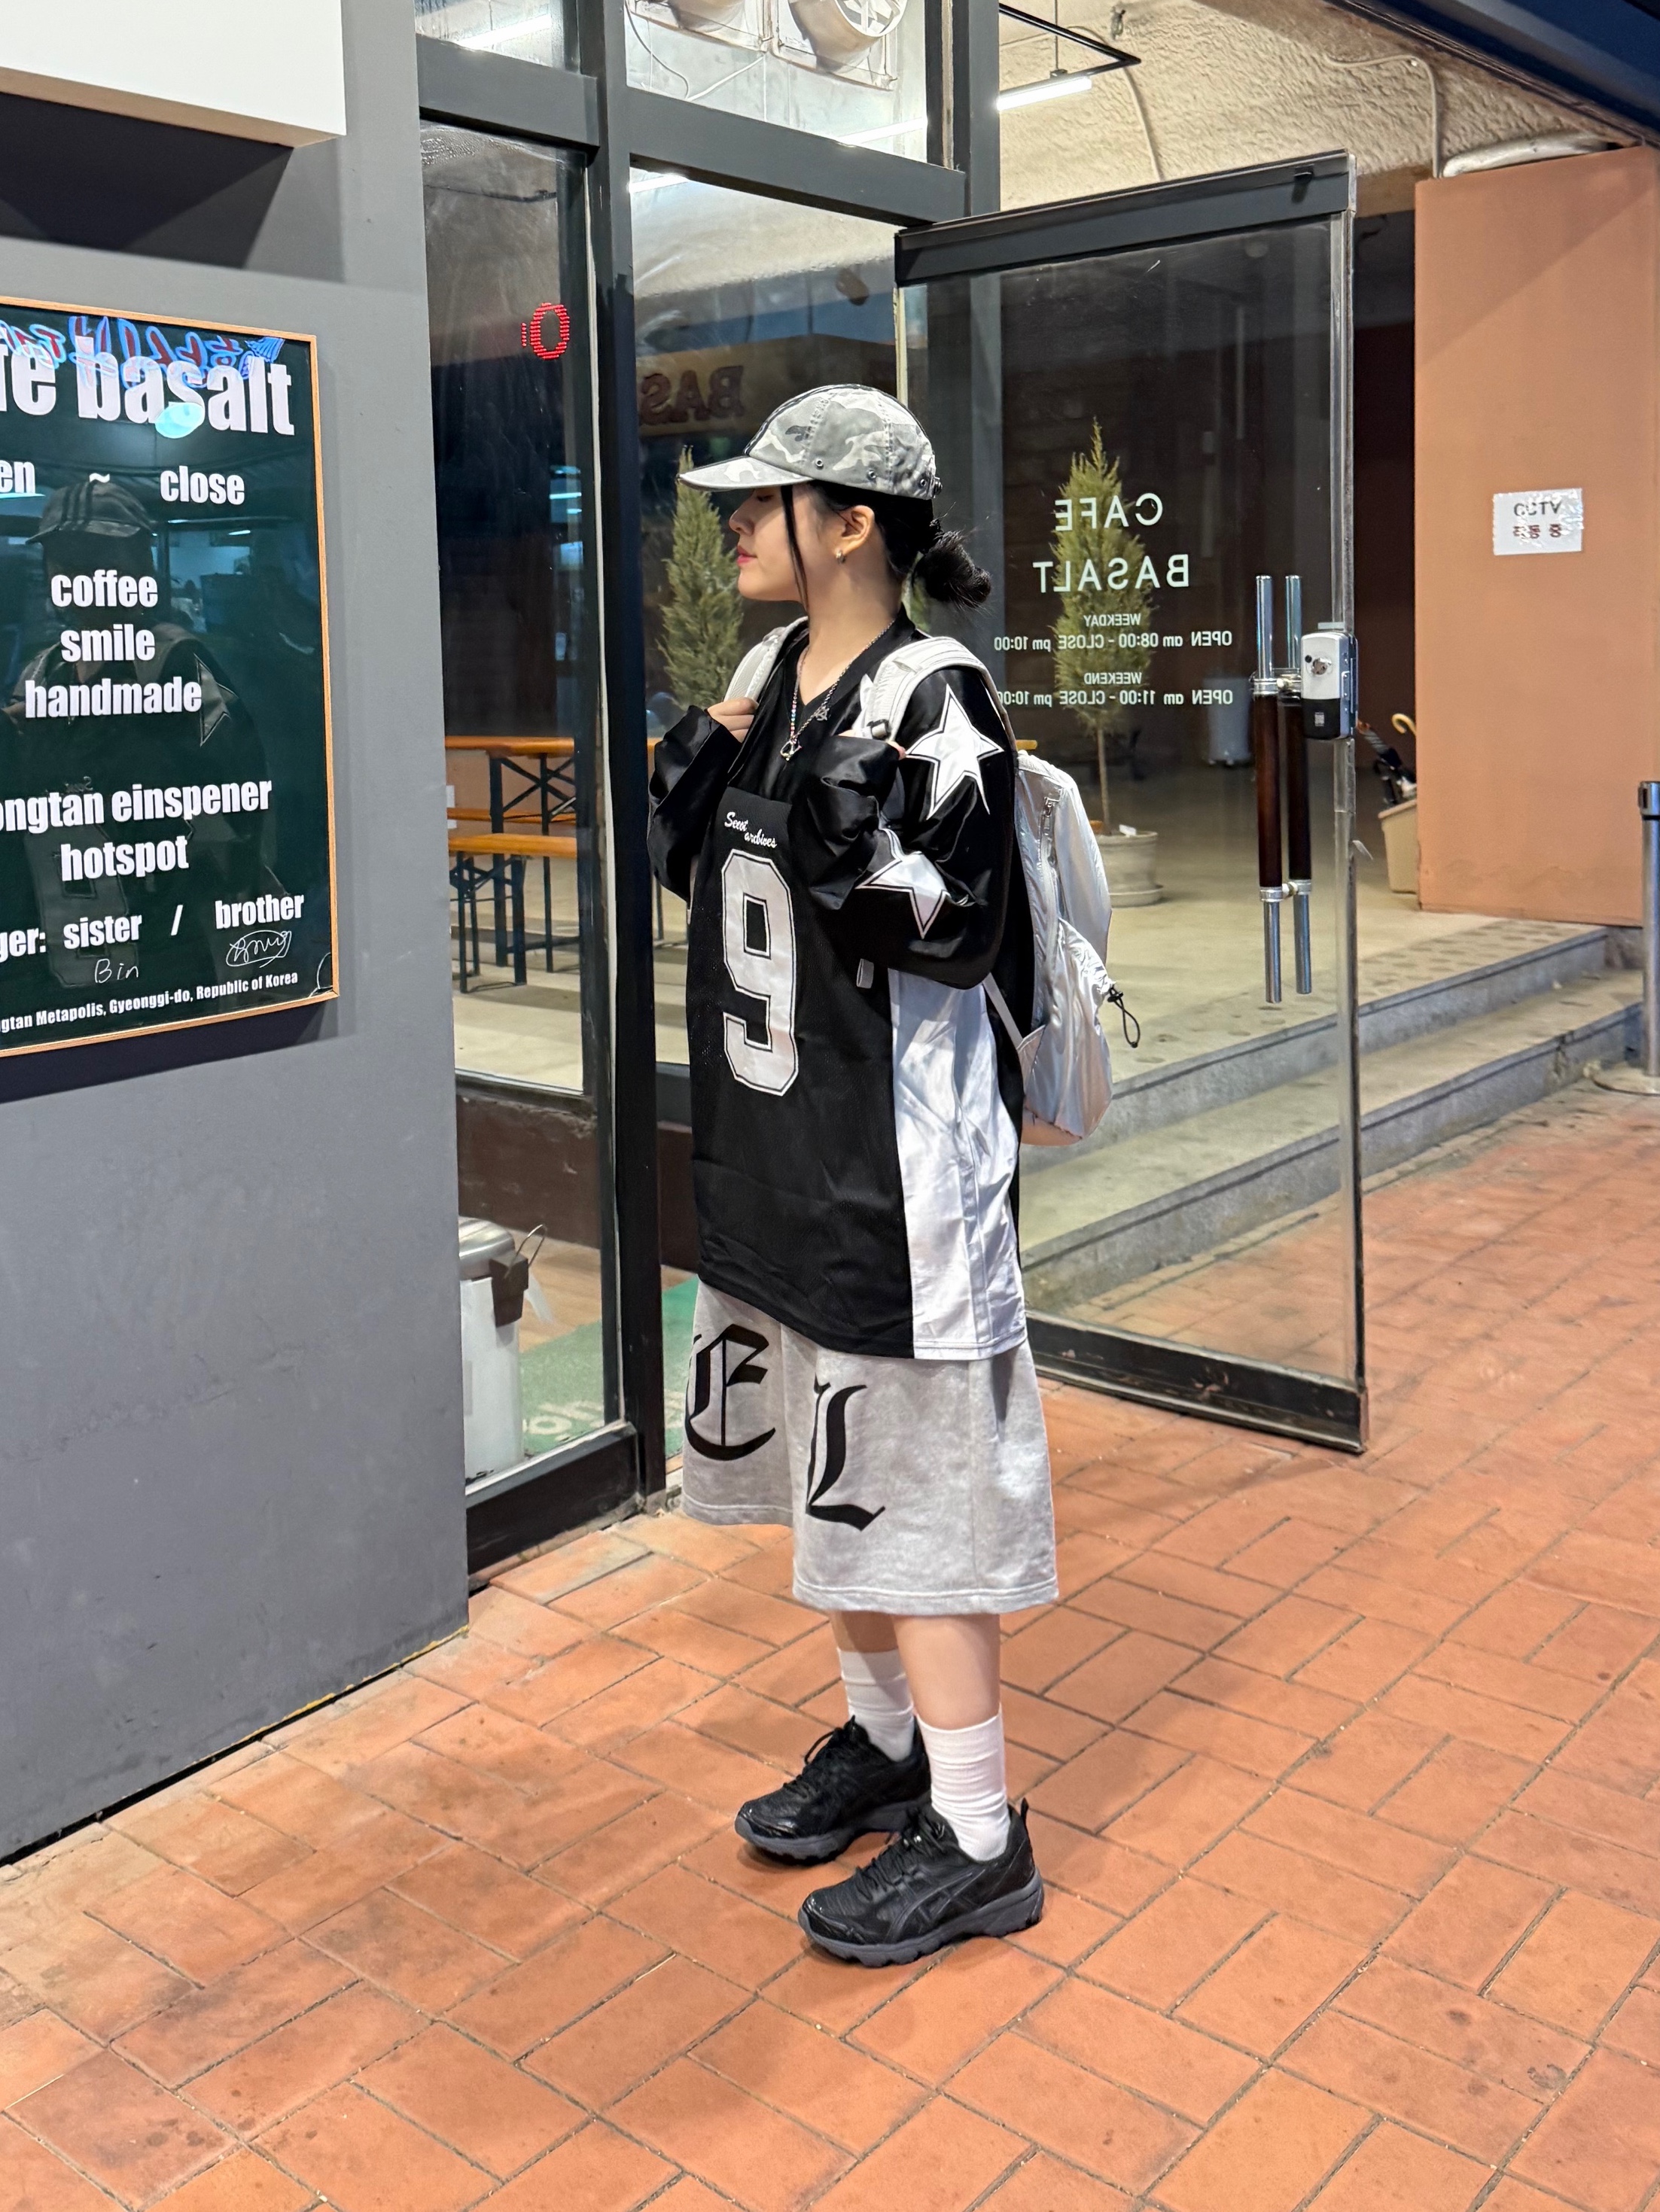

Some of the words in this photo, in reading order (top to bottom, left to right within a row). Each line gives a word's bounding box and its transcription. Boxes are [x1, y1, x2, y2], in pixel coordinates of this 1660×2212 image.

[75, 335, 294, 435] basalt
[160, 465, 245, 505] close
[1513, 501, 1562, 516] CCTV
[50, 569, 158, 607] coffee
[60, 623, 156, 662] smile
[25, 676, 203, 718] handmade
[0, 792, 105, 834] ngtan
[111, 780, 273, 822] einspener
[60, 835, 189, 881] hotspot
[63, 914, 142, 949] sister
[215, 894, 304, 930] brother
[94, 958, 139, 984] Bin
[721, 848, 799, 1097] 9
[0, 1015, 33, 1033] gtan
[36, 1003, 106, 1026] Metapolis,
[109, 988, 194, 1014] Gyeonggi-do,
[196, 979, 249, 1000] Republic
[251, 975, 263, 990] of
[265, 972, 298, 988] Korea
